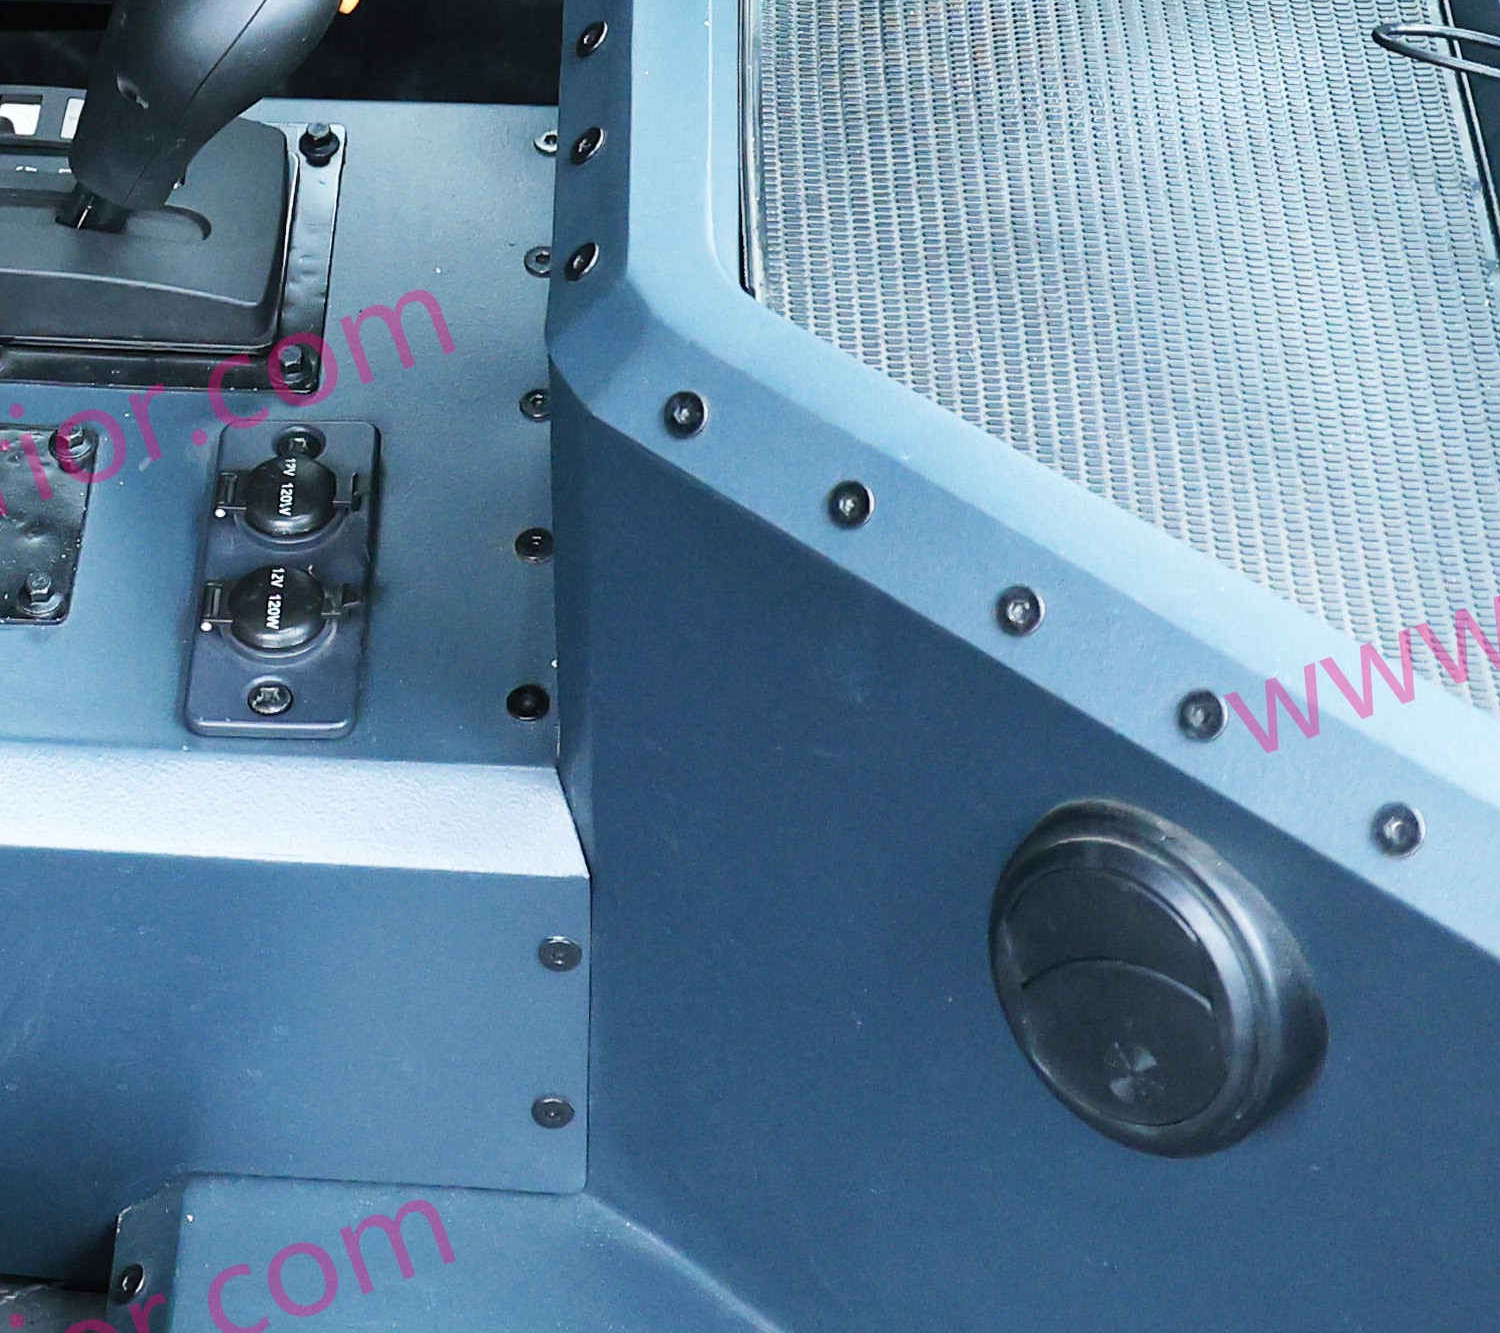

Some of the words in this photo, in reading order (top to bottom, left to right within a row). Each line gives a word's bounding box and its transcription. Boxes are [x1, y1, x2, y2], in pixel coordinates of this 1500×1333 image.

[283, 458, 297, 477] 12V
[279, 482, 294, 516] 120W
[270, 568, 285, 588] 12V
[266, 594, 282, 630] 120W
